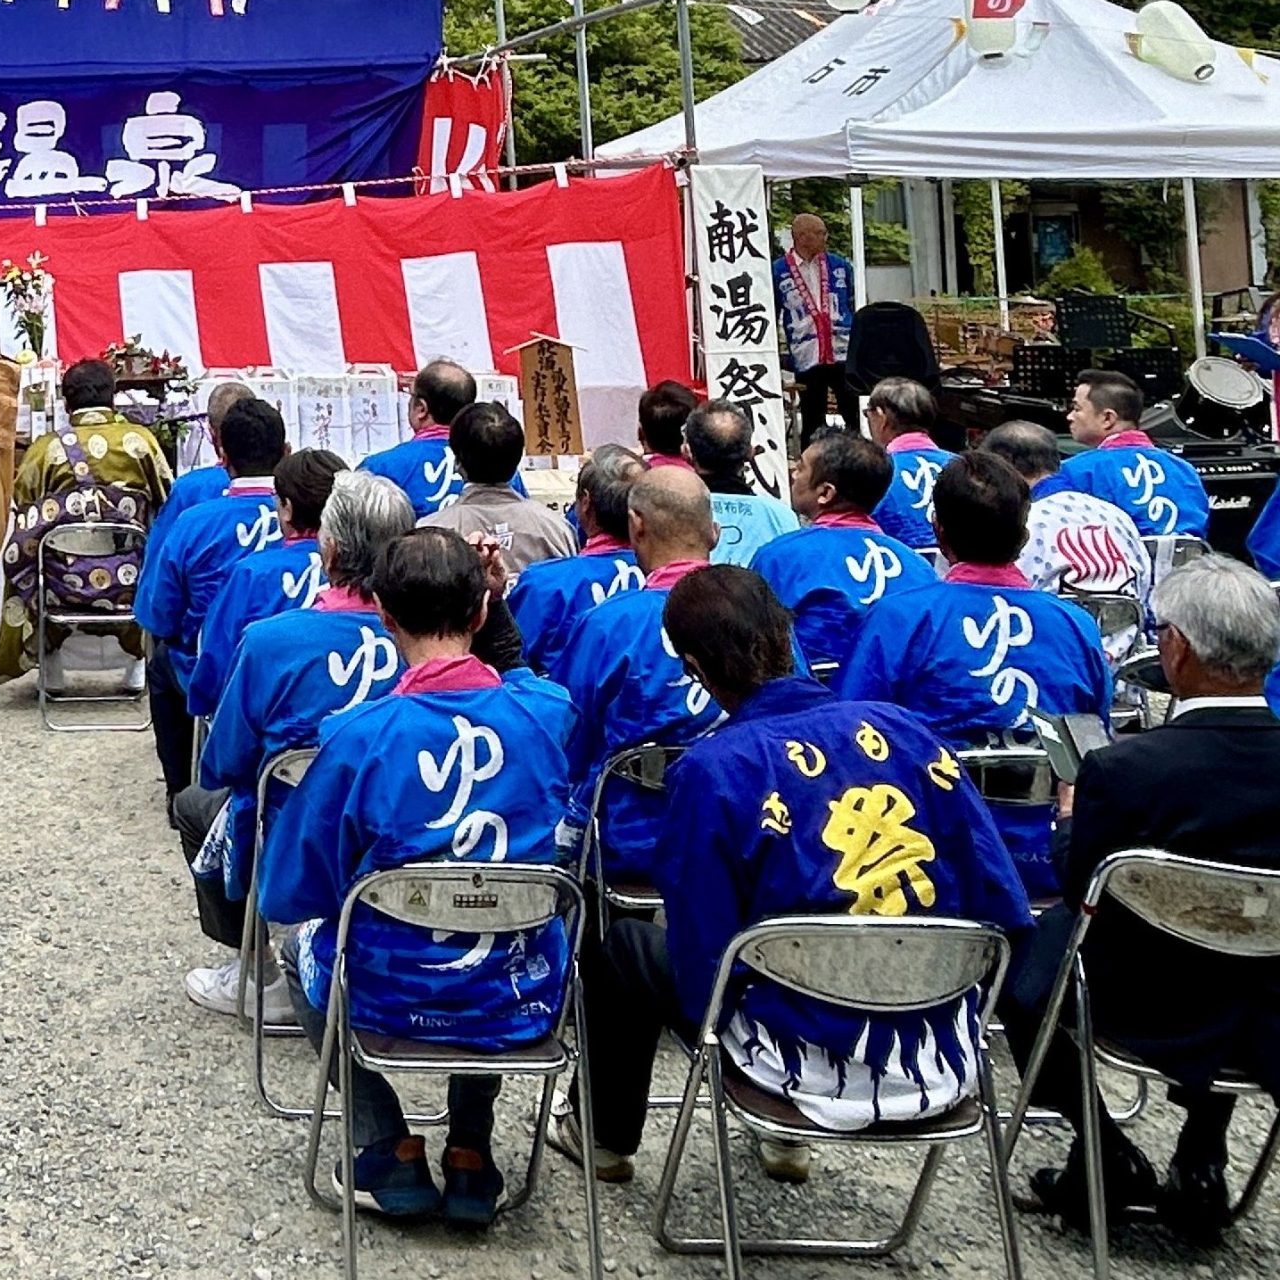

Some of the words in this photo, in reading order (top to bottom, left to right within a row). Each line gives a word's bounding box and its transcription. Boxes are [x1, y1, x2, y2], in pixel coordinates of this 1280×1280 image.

[706, 200, 781, 500] 献湯祭式
[1122, 453, 1179, 535] ゆの
[846, 538, 902, 604] ゆ
[327, 625, 398, 714] ゆ
[963, 595, 1039, 747] ゆの
[822, 784, 956, 917] 祭
